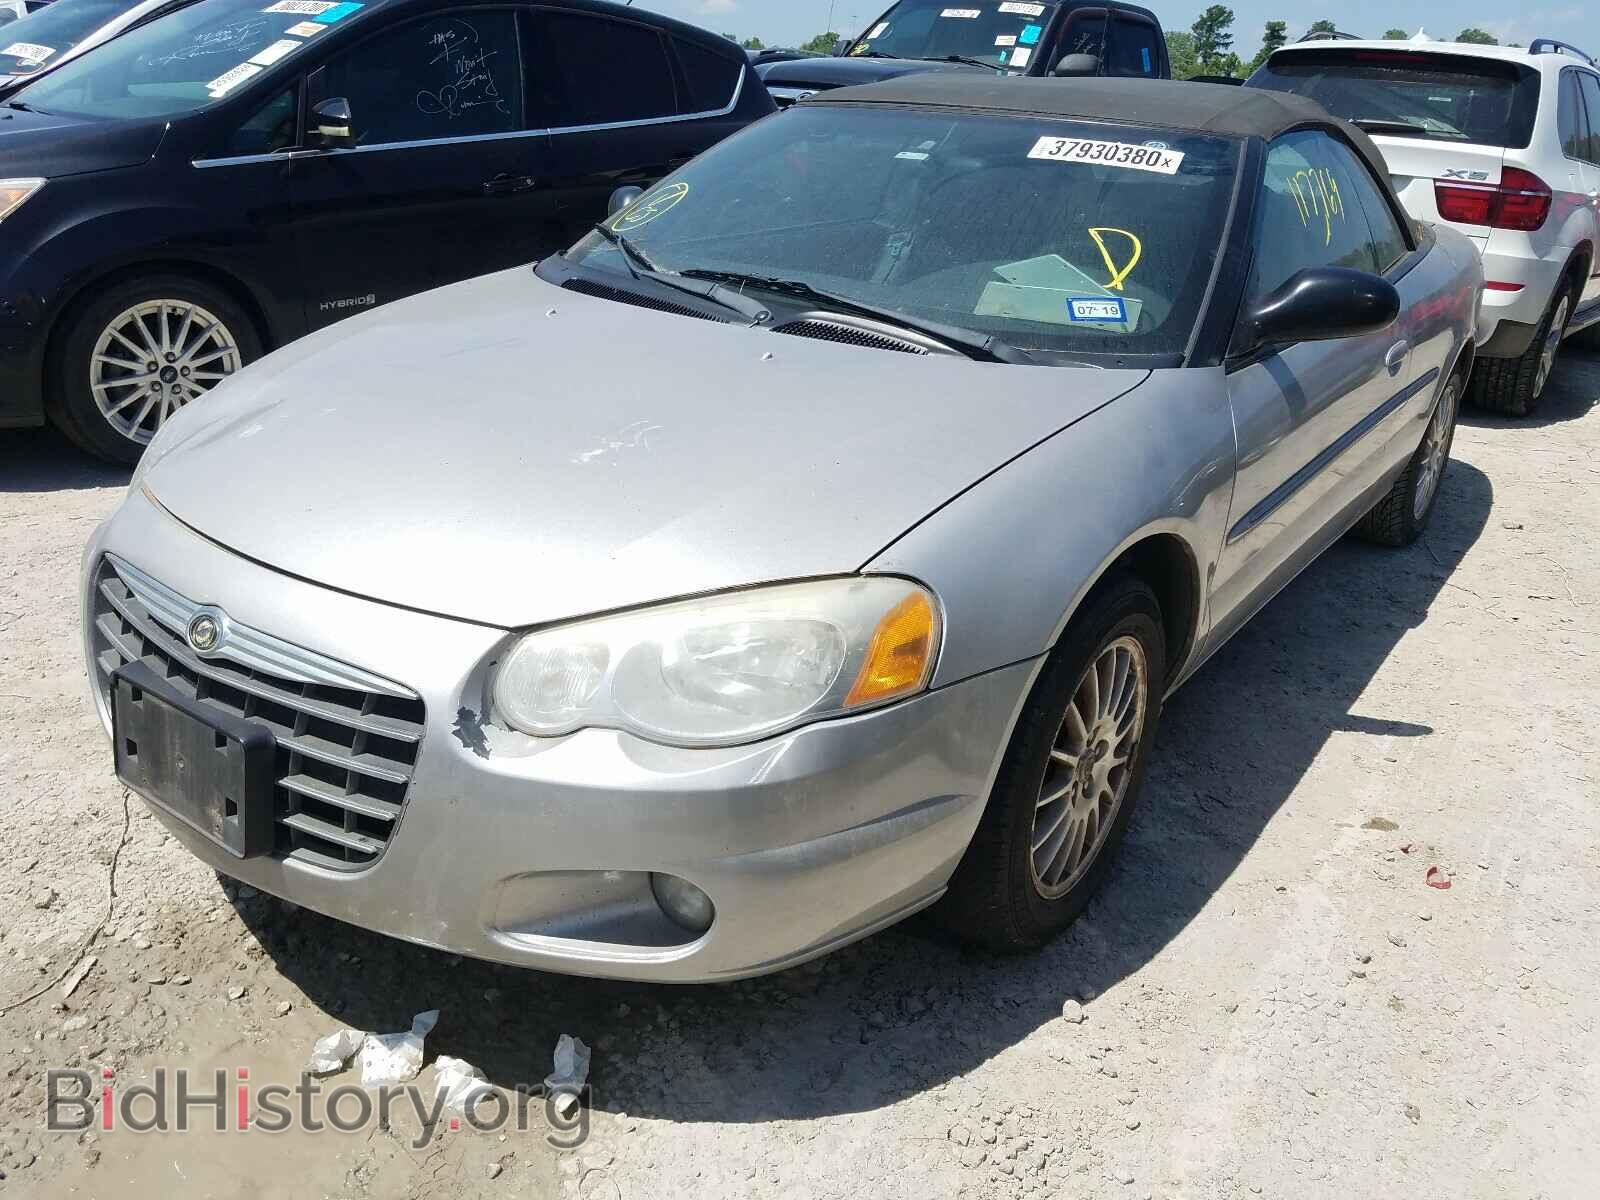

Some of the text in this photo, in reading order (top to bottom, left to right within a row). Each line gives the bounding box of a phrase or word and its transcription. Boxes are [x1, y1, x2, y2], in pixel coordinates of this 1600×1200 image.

[1048, 140, 1162, 168] 37930380
[1440, 168, 1489, 181] X5
[320, 296, 366, 311] HYBRID
